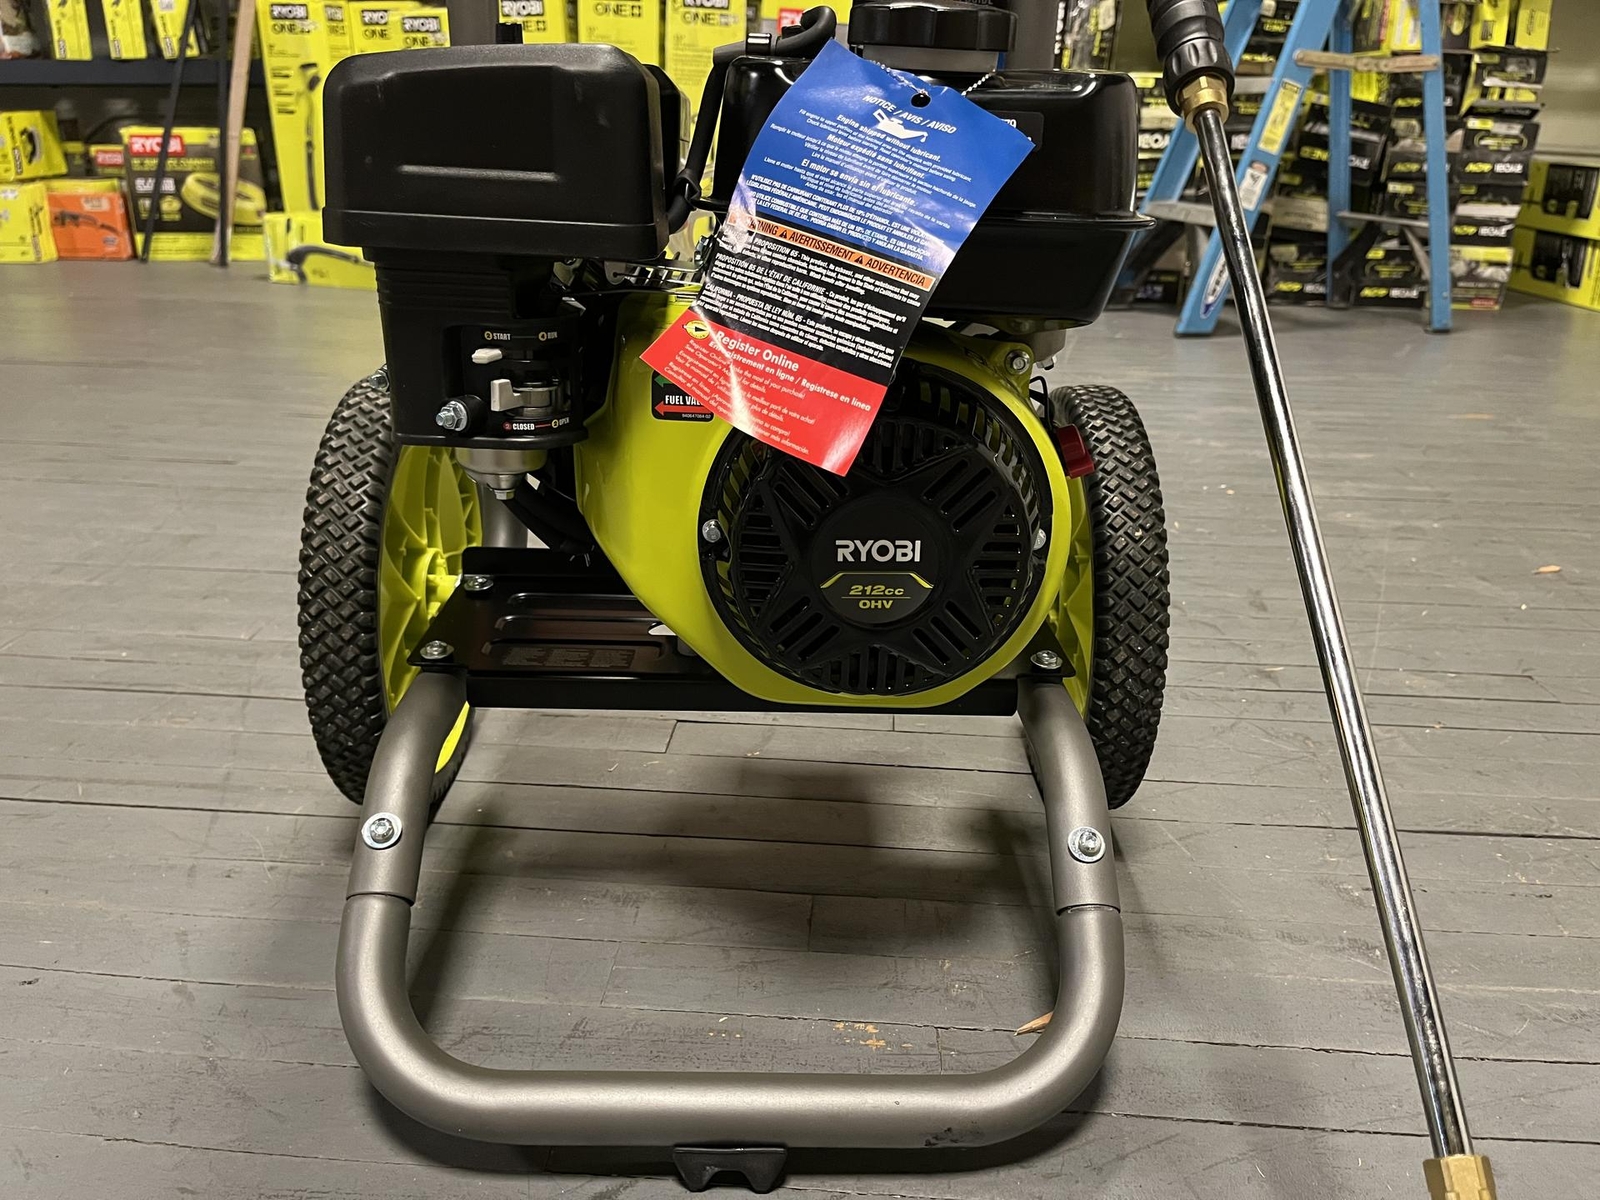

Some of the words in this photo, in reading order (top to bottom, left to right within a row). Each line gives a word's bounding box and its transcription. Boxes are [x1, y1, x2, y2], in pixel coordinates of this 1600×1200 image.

[862, 95, 895, 111] NOTICE
[900, 111, 922, 123] AVIS
[926, 120, 956, 133] AVISO
[826, 133, 850, 146] Moteur
[850, 144, 876, 157] expédié
[876, 154, 893, 164] sans
[836, 114, 859, 128] Engine
[858, 125, 886, 138] shipped
[885, 136, 910, 150] without
[910, 146, 941, 162] lubricant.
[801, 158, 810, 166] El
[808, 162, 830, 173] motor
[859, 180, 870, 188] sin
[753, 237, 790, 254] PROPOSITION
[788, 231, 854, 259] AVERTISSEMENT
[865, 258, 925, 285] ADVERTENCIA
[715, 252, 748, 268] PROPOSITION
[755, 266, 764, 274] DE
[764, 268, 783, 280] L'ÉTAT
[782, 274, 792, 283] DE
[791, 278, 825, 294] CALIFORNIE
[735, 293, 764, 308] PROPUESTA
[763, 303, 772, 311] DE
[771, 306, 782, 314] LEY
[713, 330, 760, 355] Register
[762, 349, 798, 371] Online
[708, 341, 764, 369] Enrgistrement
[775, 368, 794, 382] ligne
[839, 394, 850, 403] en
[665, 395, 684, 405] FUEL
[685, 396, 704, 405] VAL
[512, 423, 535, 431] CLOSED
[836, 540, 921, 562] RYOBI
[849, 585, 905, 596] 212cc
[859, 600, 893, 609] OHV
